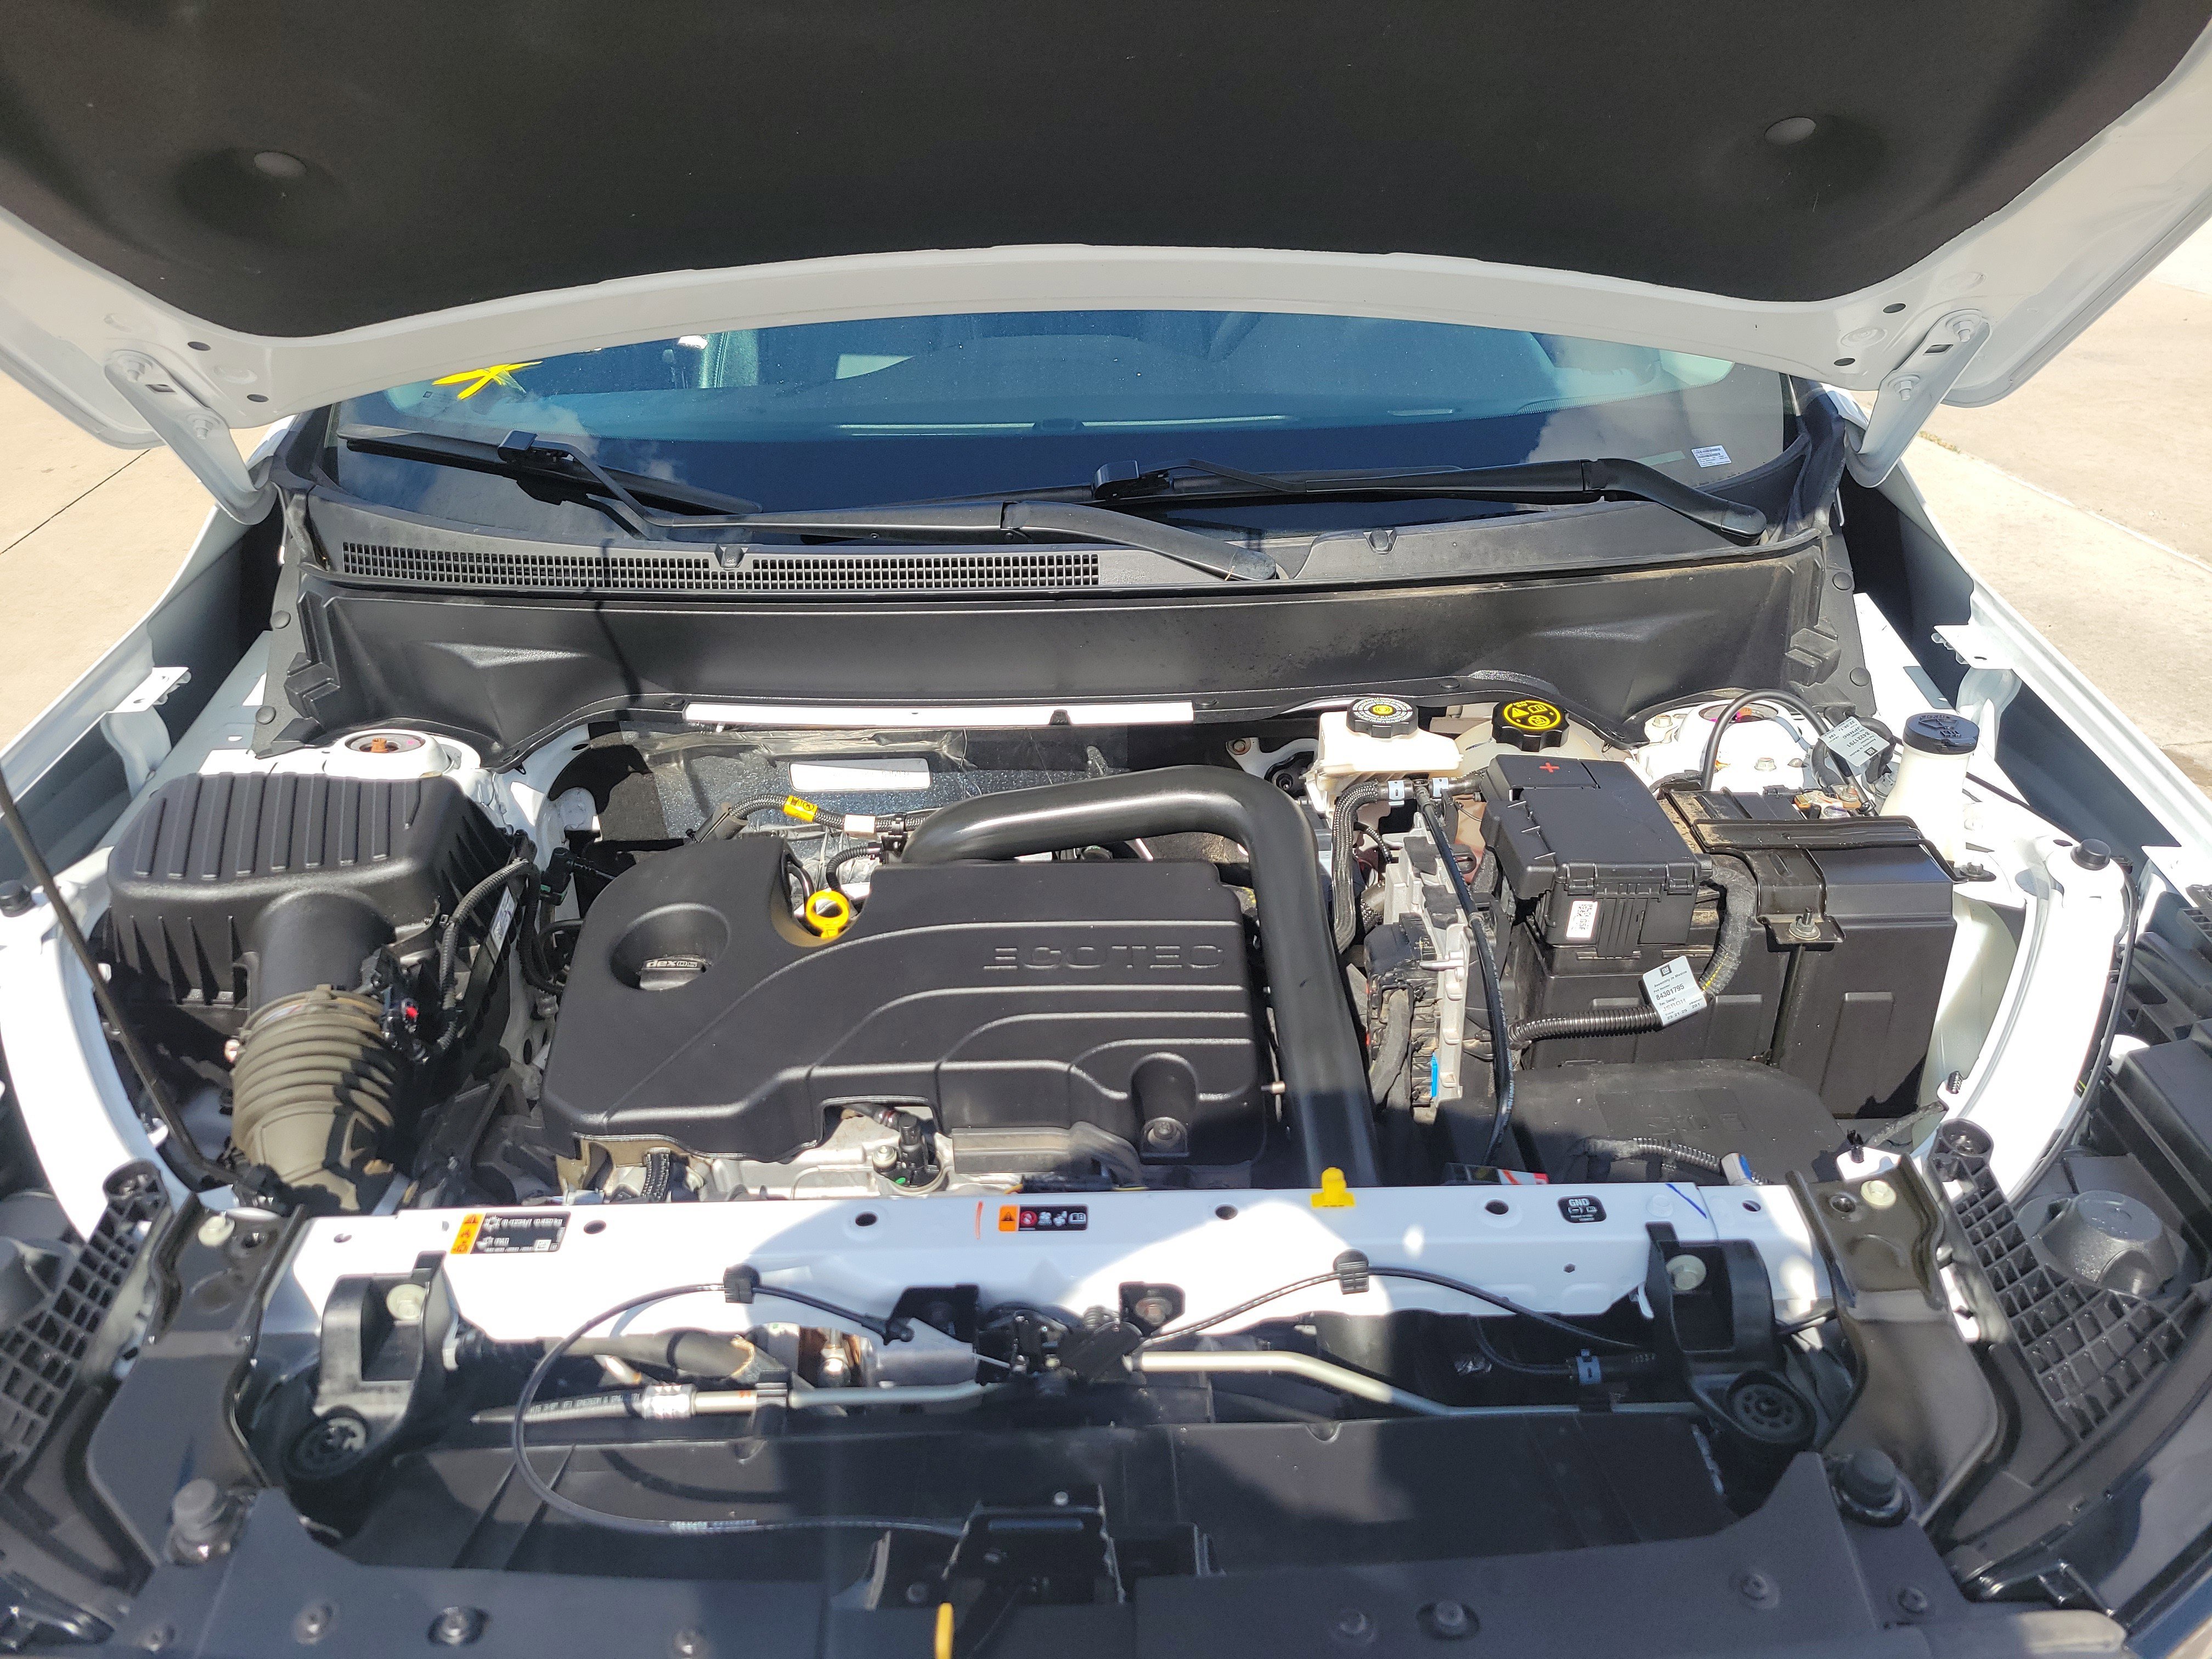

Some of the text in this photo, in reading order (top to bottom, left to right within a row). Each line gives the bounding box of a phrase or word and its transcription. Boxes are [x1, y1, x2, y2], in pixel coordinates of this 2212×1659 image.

[984, 945, 1225, 969] ECOTEC
[1656, 983, 1684, 1000] 84301795
[1569, 1198, 1590, 1206] GND
